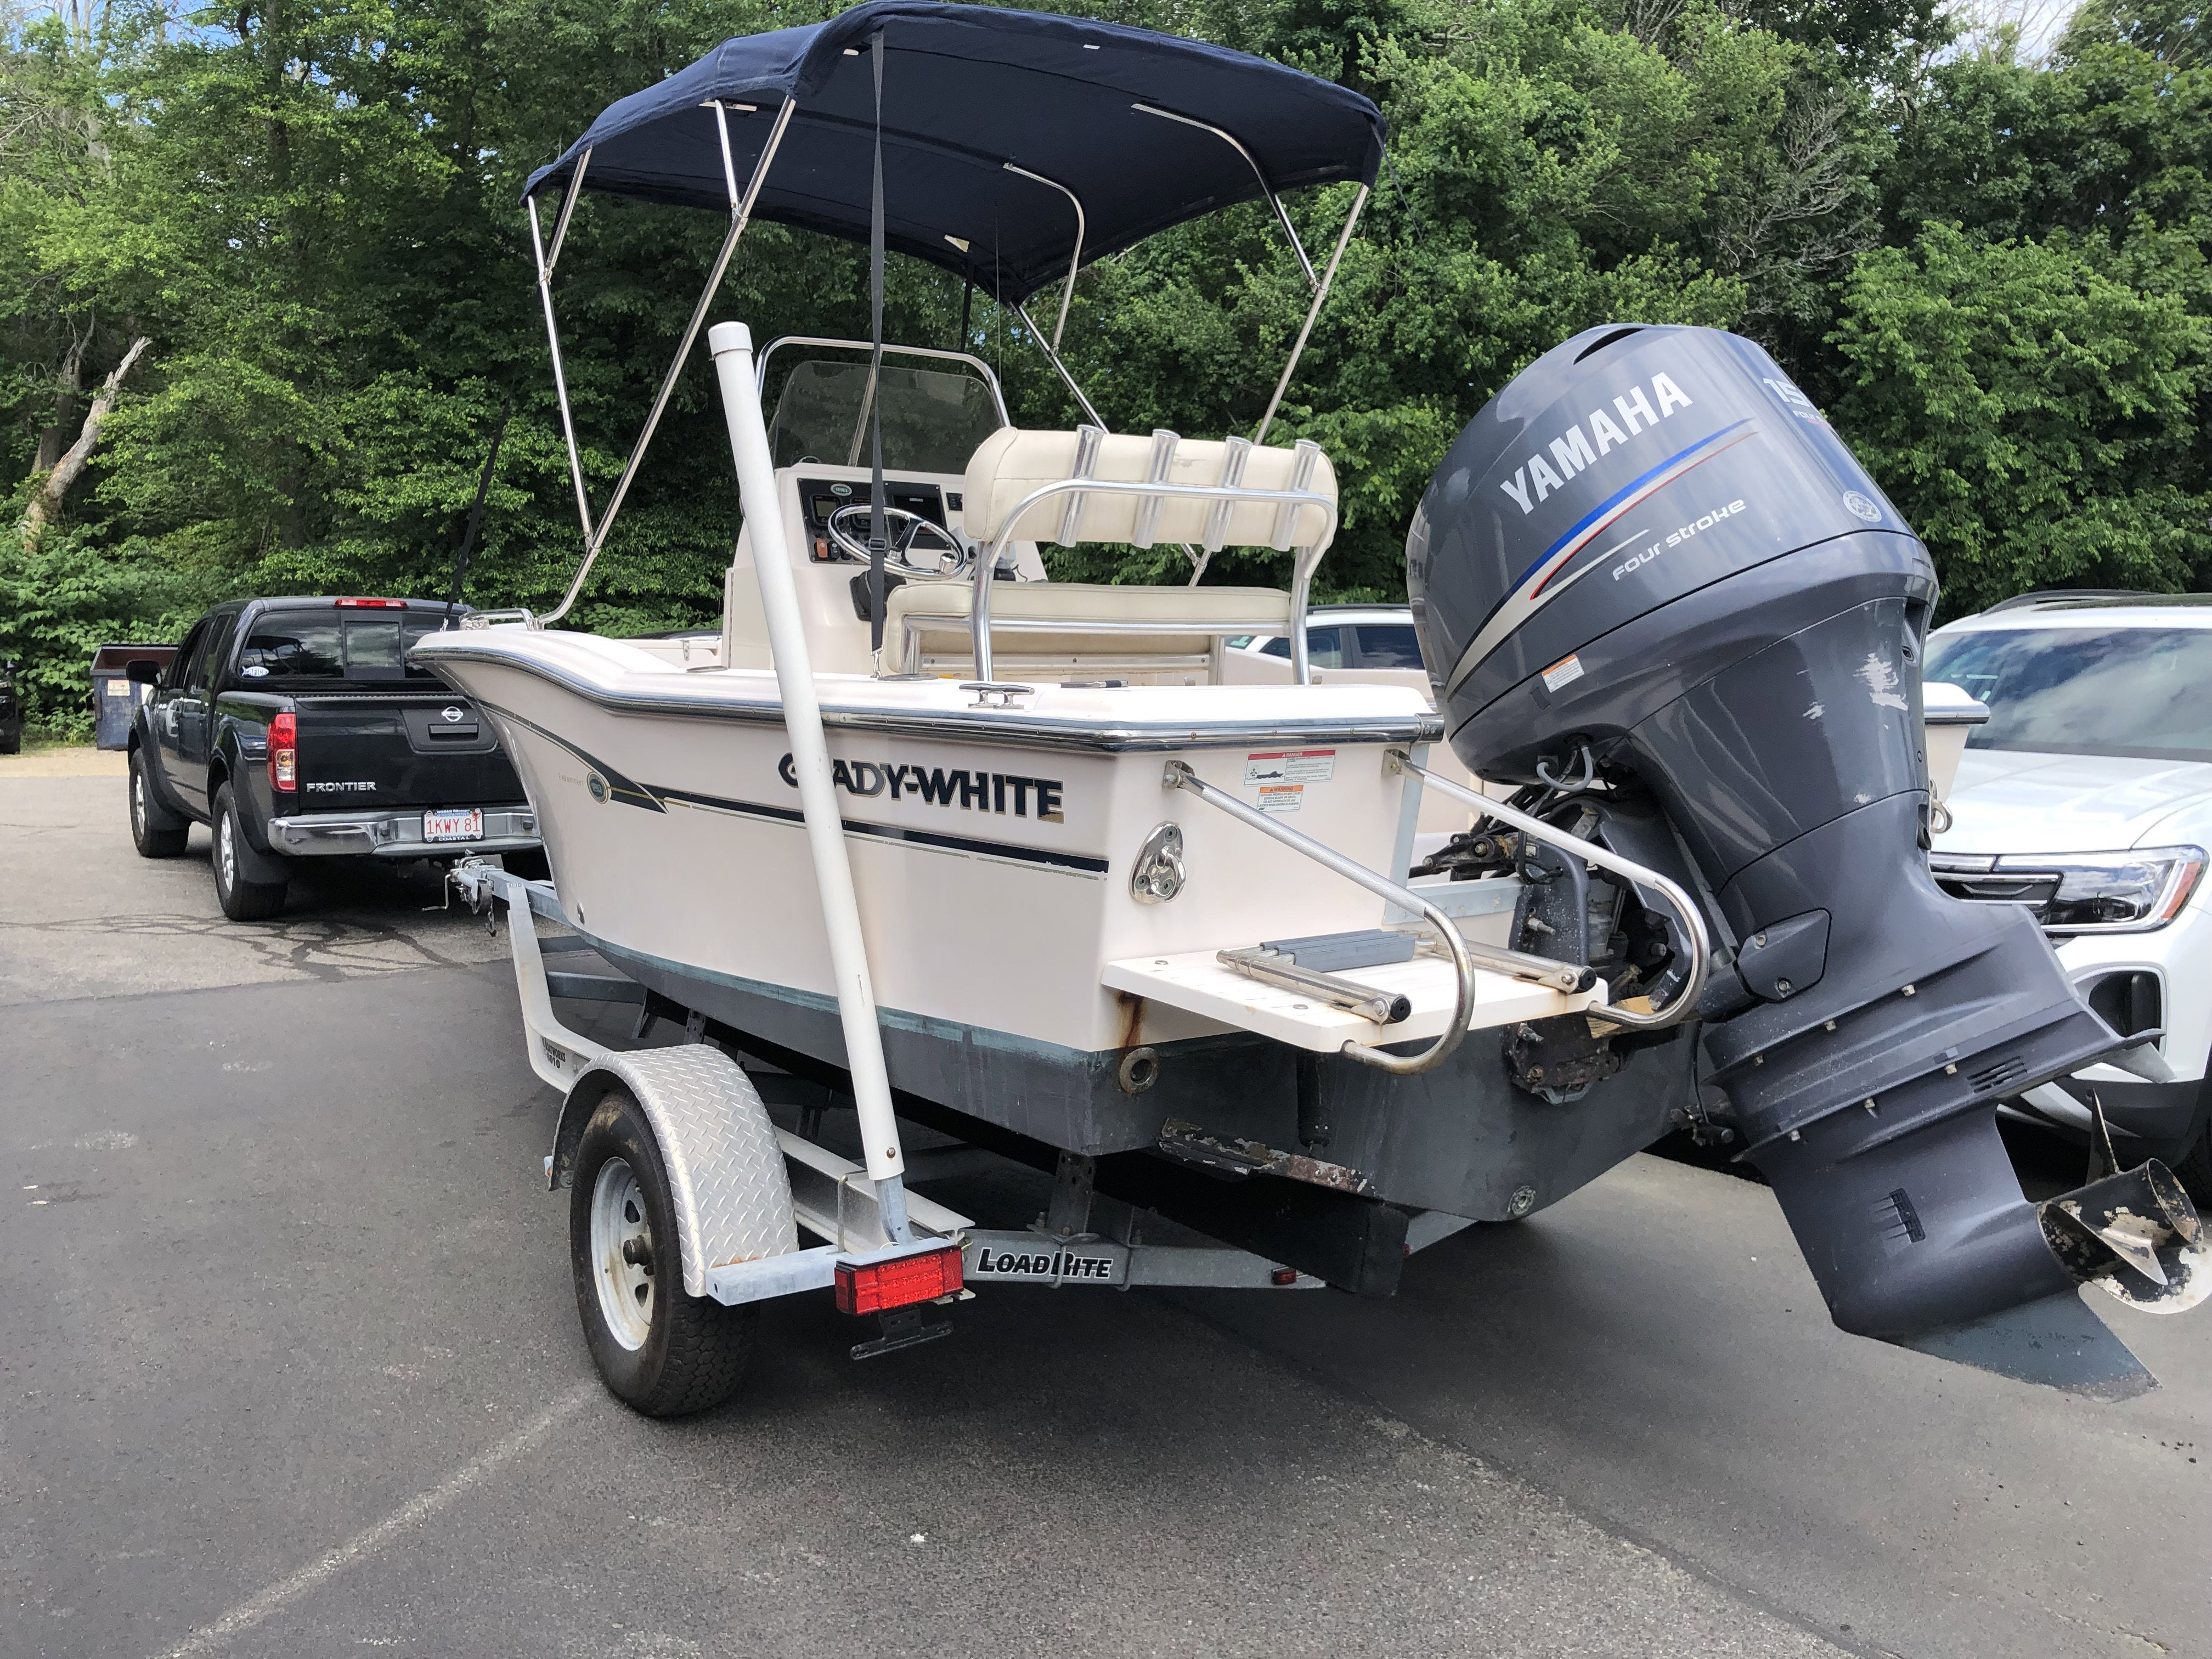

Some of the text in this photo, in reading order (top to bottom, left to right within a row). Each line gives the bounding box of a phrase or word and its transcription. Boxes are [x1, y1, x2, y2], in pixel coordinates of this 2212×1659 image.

[1763, 377, 1811, 408] 15
[1499, 372, 1694, 515] YAMAHA
[306, 782, 377, 792] FRONTIER
[778, 752, 1064, 824] GADY-WHITE
[427, 817, 481, 834] 1KWY 81
